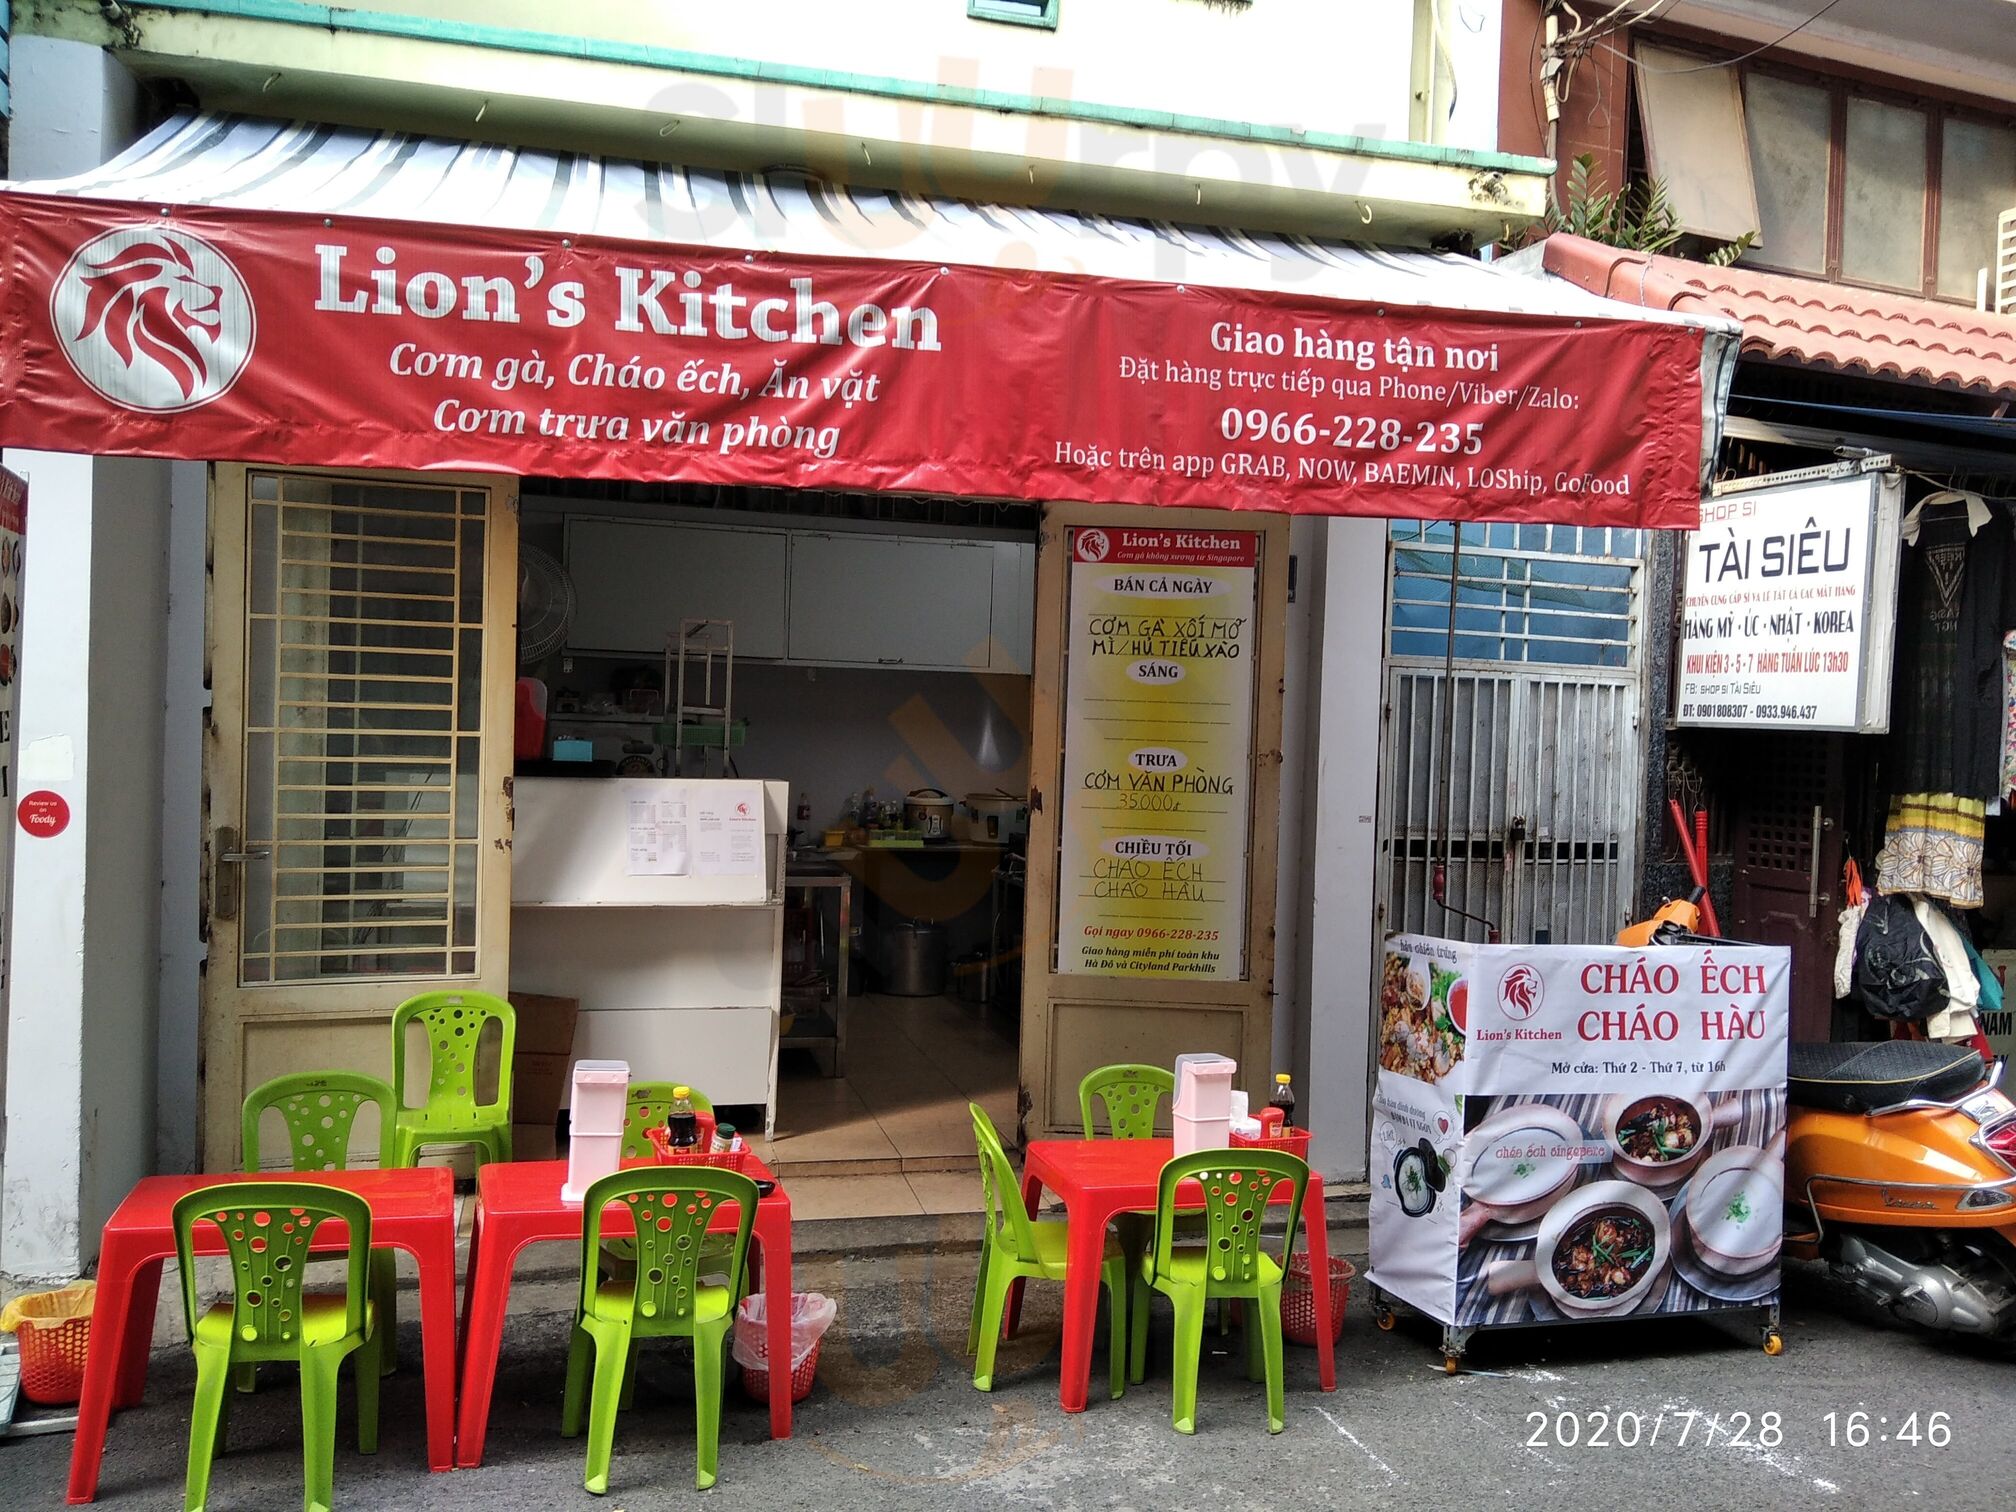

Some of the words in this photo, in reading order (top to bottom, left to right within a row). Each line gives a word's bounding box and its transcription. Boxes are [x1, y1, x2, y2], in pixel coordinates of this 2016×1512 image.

[614, 267, 942, 352] Kitchen
[1210, 321, 1284, 356] Giao
[1294, 325, 1376, 370] hàng
[1384, 335, 1437, 374] tận
[1445, 340, 1499, 373] nơi
[389, 342, 483, 382] Cơm
[497, 349, 555, 389] gà,
[569, 352, 666, 392] Cháo
[677, 359, 749, 401] ếch,
[762, 358, 809, 400] Ăn
[823, 371, 880, 406] vặt
[1119, 355, 1159, 382] Đặt
[1165, 361, 1223, 391] hàng
[1227, 366, 1276, 391] trực
[1281, 368, 1325, 399] tiếp
[1331, 378, 1372, 401] qua
[1379, 377, 1580, 411] Phone/Viber/Zalo:
[433, 400, 525, 436] Cơm
[539, 406, 628, 442] trưa
[642, 410, 719, 446] văn
[721, 414, 841, 459] phòng
[1220, 407, 1484, 455] 0966-228-235
[1054, 441, 1112, 469] Hoặc
[1118, 444, 1165, 470] trên
[1172, 454, 1215, 478] app
[1220, 454, 1292, 481] GRAB,
[1297, 458, 1357, 484] NOW,
[1364, 463, 1461, 490] BAEMIN,
[1467, 467, 1548, 496] LOShip,
[1554, 472, 1631, 496] GoFood
[1176, 534, 1240, 550] Kitchen
[1699, 527, 1751, 583] TÀI
[1761, 517, 1851, 577] SIÊU
[1207, 554, 1244, 564] Singapore
[1114, 576, 1144, 592] BÁN
[1149, 578, 1168, 592] CẢ
[1172, 578, 1212, 593] NGÀY
[1090, 616, 1130, 636] CƠM
[1138, 618, 1165, 636] GÀ
[1684, 611, 1713, 640] HÀNG
[1744, 608, 1759, 637] ÚC
[1769, 606, 1803, 643] NHẬT
[1813, 610, 1854, 634] KOREA
[1204, 640, 1240, 658] XÀO
[1138, 662, 1178, 678] SÁNG
[1686, 655, 1704, 674] KHUI
[1724, 654, 1729, 673] 3
[1736, 654, 1741, 673] 5
[1748, 654, 1753, 673] 7
[1823, 652, 1849, 672] 13h30
[1683, 704, 1694, 717] ĐT:
[1697, 704, 1748, 718] 0901808307
[1756, 705, 1817, 720] 0933.946.437
[1136, 754, 1177, 768] TRƯA
[1129, 771, 1165, 792] VĂN
[1172, 767, 1234, 795] PHÒNG
[30, 814, 56, 828] Foody
[1115, 838, 1160, 854] CHIỀU
[1166, 840, 1192, 856] TỐI
[1094, 855, 1150, 879] CHÁO
[1163, 857, 1203, 882] ẾCH
[1094, 880, 1148, 898] CHÁO
[1162, 882, 1205, 902] HÀU
[1084, 926, 1102, 938] Gọi
[1105, 928, 1134, 939] ngay
[1136, 928, 1219, 940] 0966-228-235
[1082, 946, 1104, 956] Giao
[1106, 947, 1130, 958] hàng
[1132, 948, 1156, 958] miễn
[1158, 949, 1175, 960] phí
[1177, 950, 1198, 960] toàn
[1200, 950, 1220, 960] khu
[1084, 959, 1098, 968] Hà
[1116, 960, 1128, 969] và
[1130, 961, 1170, 972] Cityland
[1172, 963, 1216, 973] Parkhills
[1580, 957, 1679, 995] CHÁO
[1700, 950, 1768, 994] ẾCH
[1578, 1003, 1679, 1042] CHÁO
[1700, 1004, 1767, 1041] HÀU
[1514, 1028, 1562, 1041] Kitchen
[1552, 1062, 1570, 1074] Mở
[1574, 1061, 1598, 1074] cửa:
[1602, 1062, 1626, 1074] Thứ
[1630, 1062, 1638, 1074] 2
[1650, 1062, 1673, 1074] Thứ
[1676, 1062, 1688, 1075] 7,
[1692, 1062, 1704, 1073] từ
[1708, 1062, 1726, 1072] 16h
